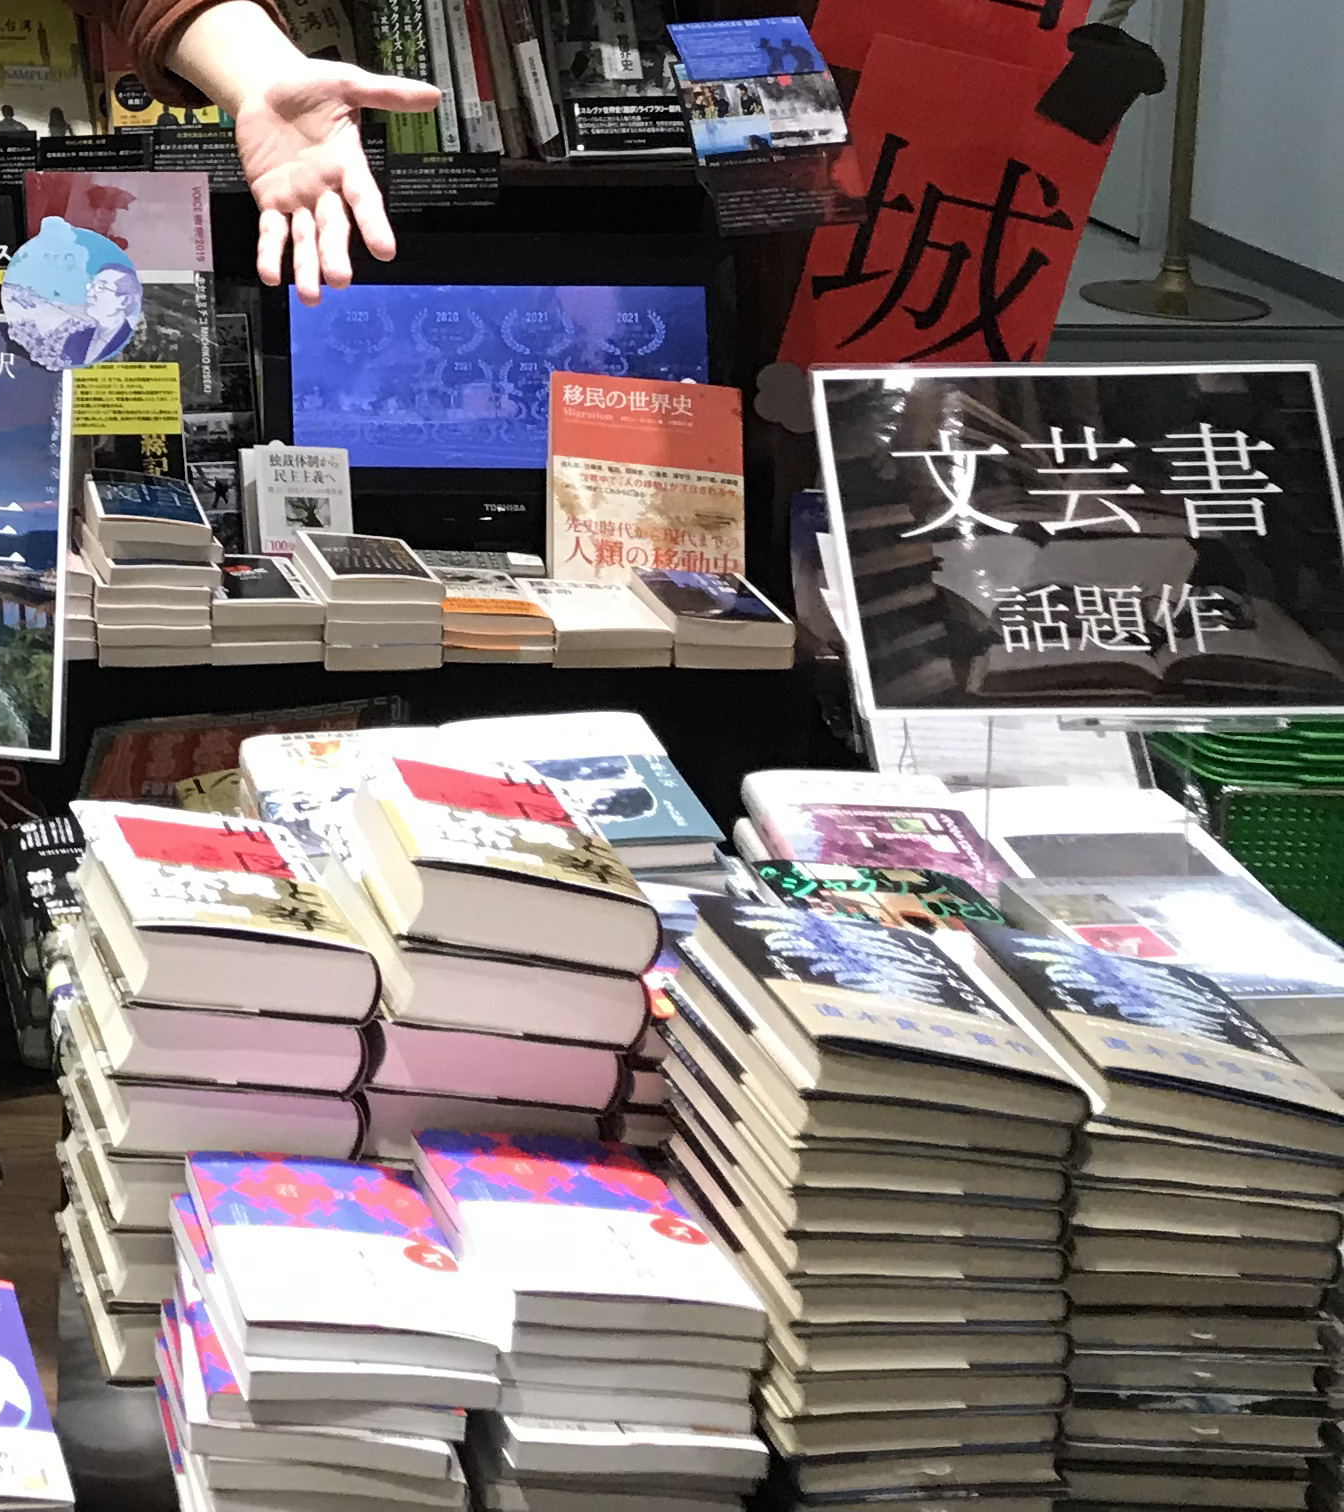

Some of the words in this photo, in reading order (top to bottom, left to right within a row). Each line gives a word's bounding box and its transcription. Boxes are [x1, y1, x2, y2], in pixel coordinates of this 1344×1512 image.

[435, 311, 459, 322] 2020
[525, 311, 549, 322] 2021
[616, 311, 640, 323] 2021
[562, 383, 693, 417] 移民の世界史
[268, 453, 340, 469] 独裁体制から
[273, 469, 337, 485] 民主主義へ
[890, 422, 1284, 539] 文芸書
[565, 517, 740, 550] 先史時代から現代までの
[993, 582, 1232, 656] 話題作
